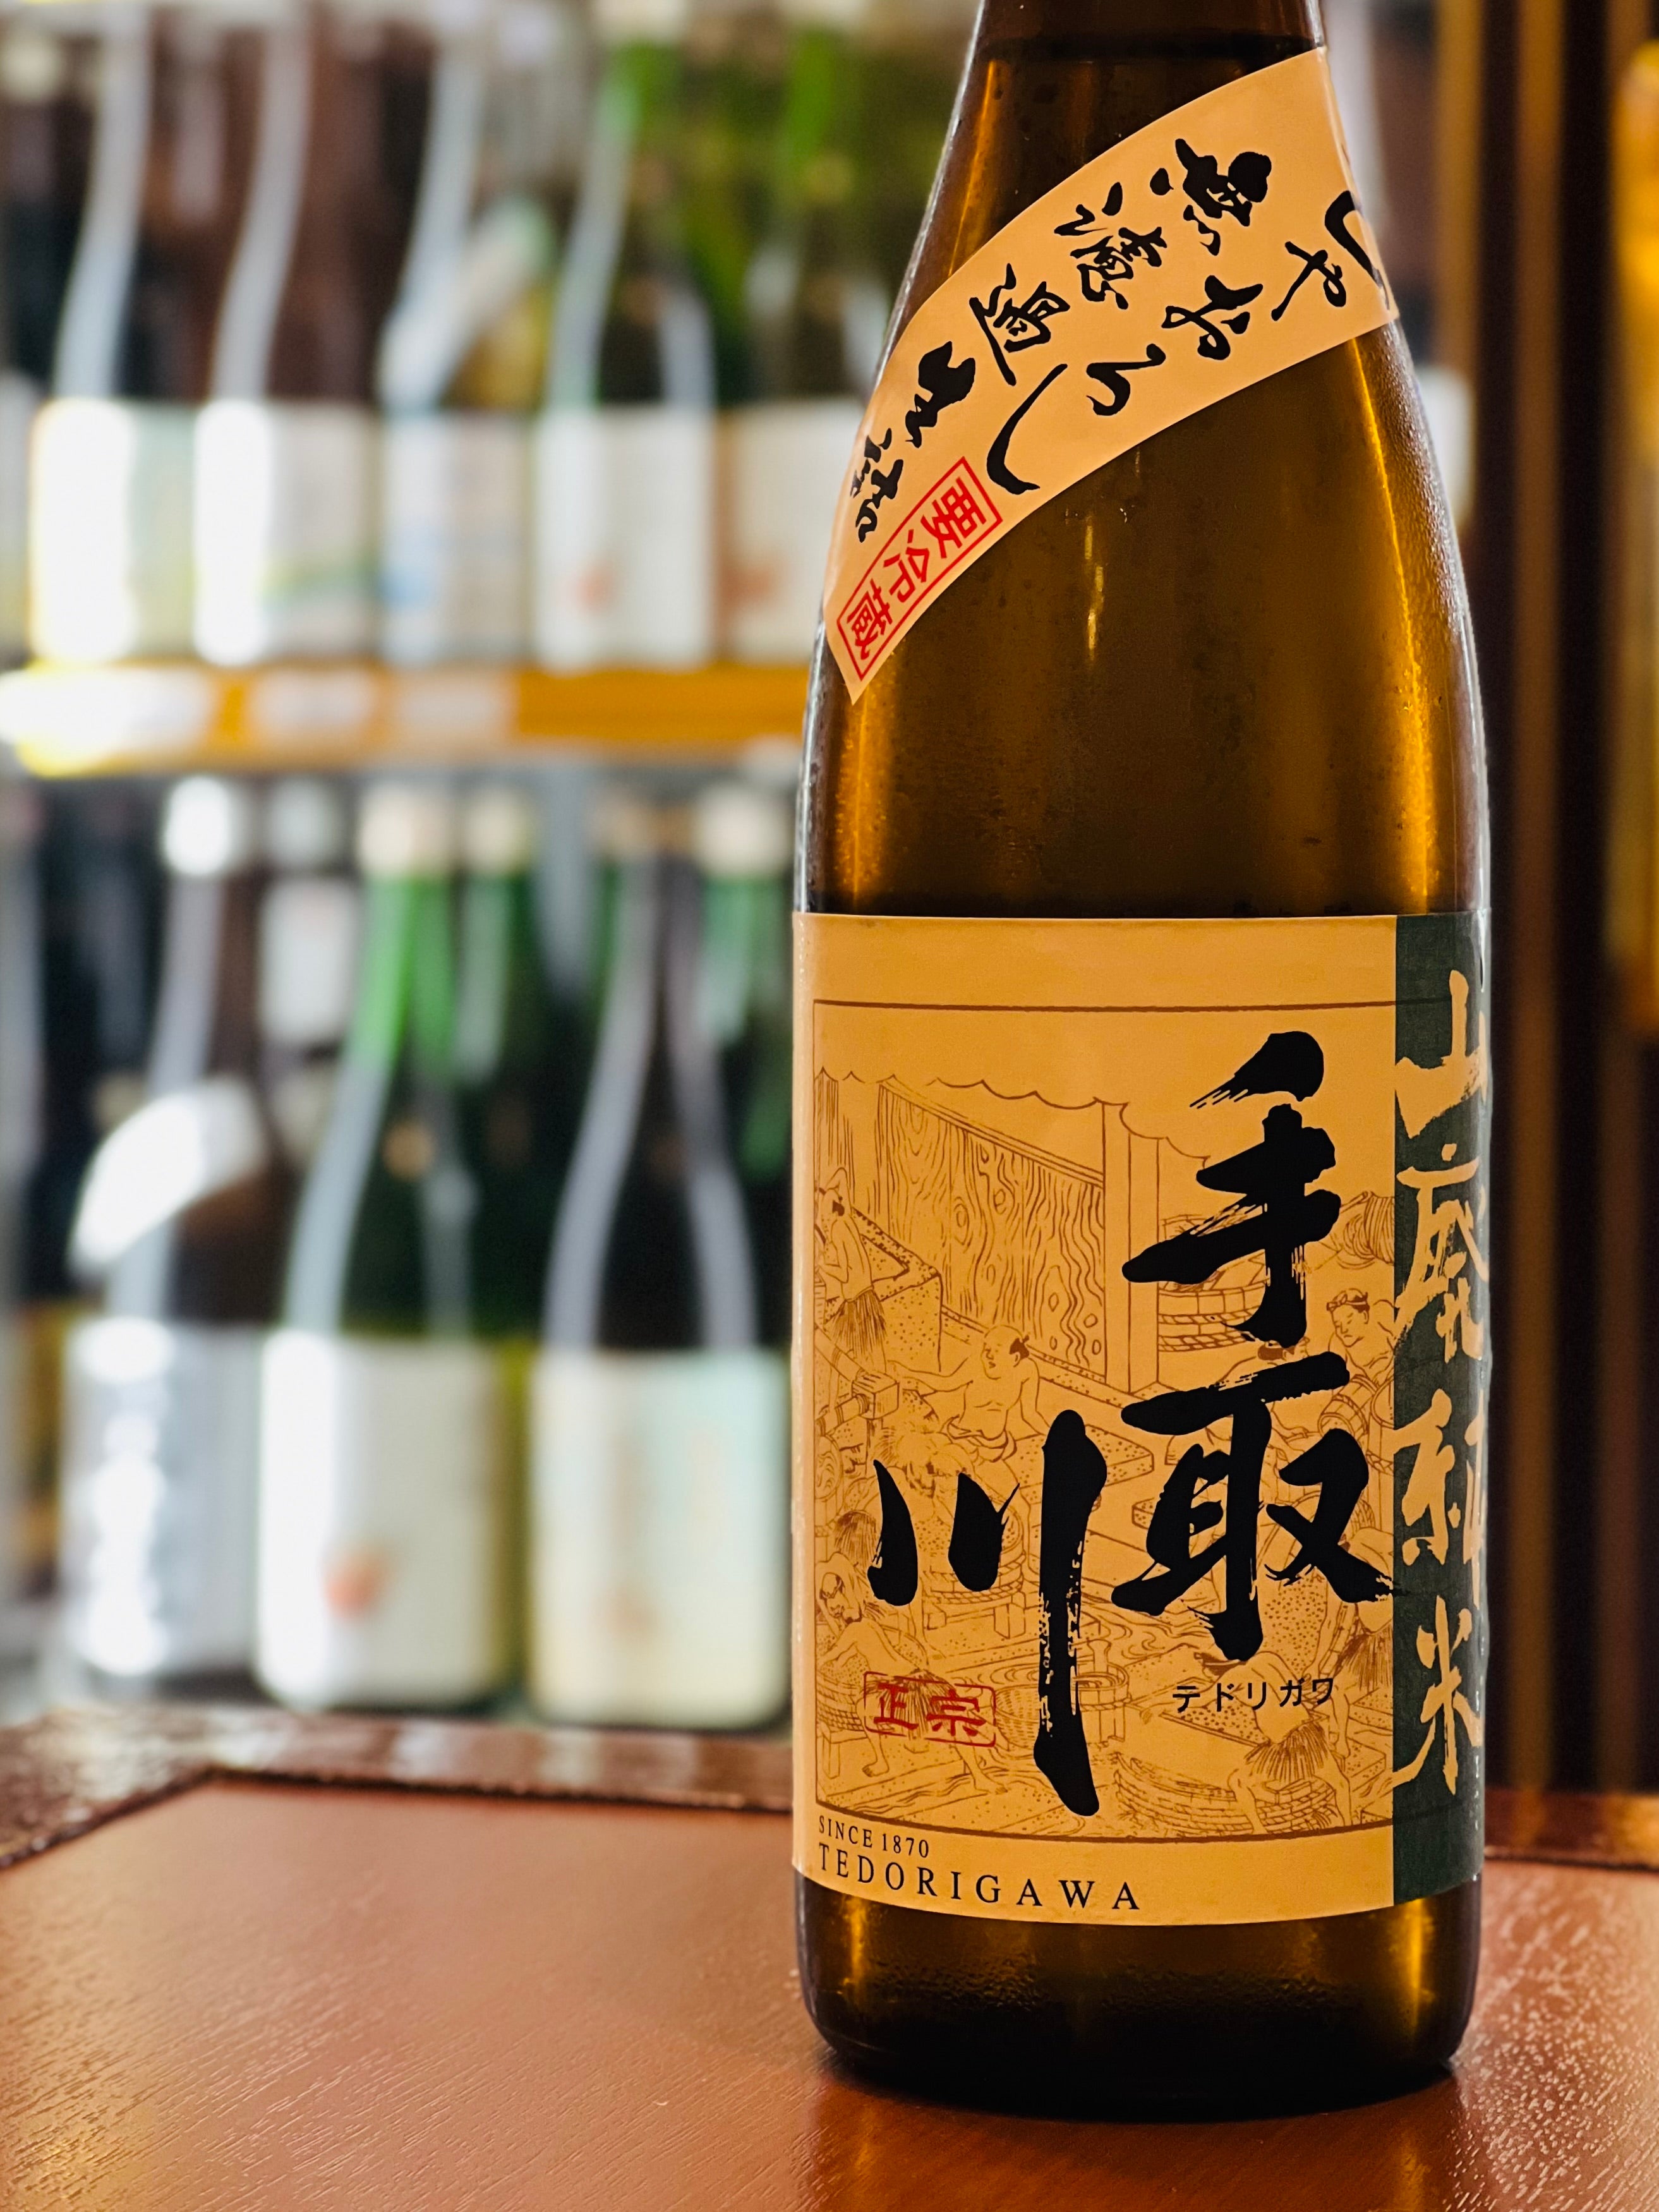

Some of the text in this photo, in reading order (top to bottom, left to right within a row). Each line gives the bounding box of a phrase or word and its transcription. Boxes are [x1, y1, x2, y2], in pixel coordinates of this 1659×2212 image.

[847, 475, 987, 660] 要冷蔵
[873, 1681, 987, 1737] 正宗
[1172, 1677, 1334, 1713] テドリガワ
[819, 1815, 929, 1859] SINCE 1870
[819, 1842, 1140, 1910] TEDORIGAWA
